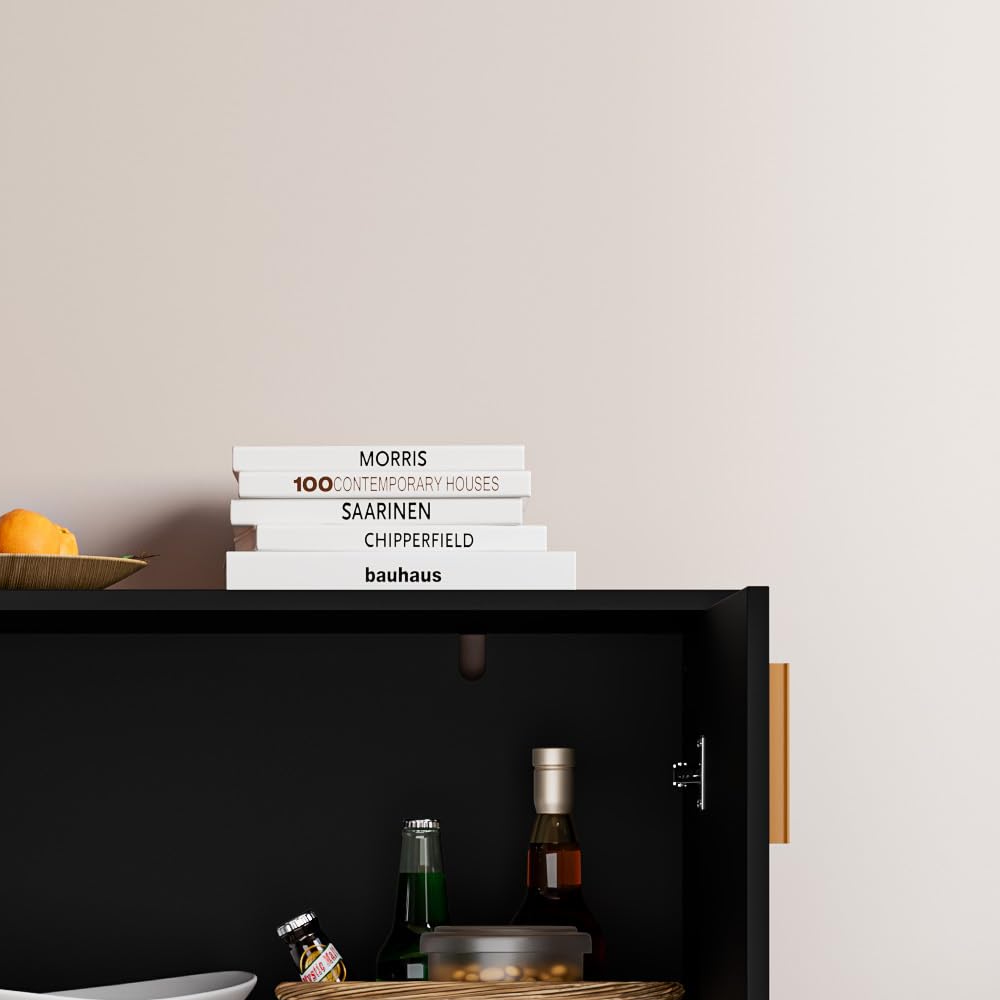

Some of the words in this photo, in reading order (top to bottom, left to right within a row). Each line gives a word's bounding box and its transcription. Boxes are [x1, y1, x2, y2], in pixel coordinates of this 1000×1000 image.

[359, 450, 427, 467] MORRIS
[446, 475, 500, 492] HOUSES
[341, 501, 431, 521] SAARINEN
[364, 532, 474, 548] CHIPPERFIELD
[365, 566, 442, 583] bauhaus
